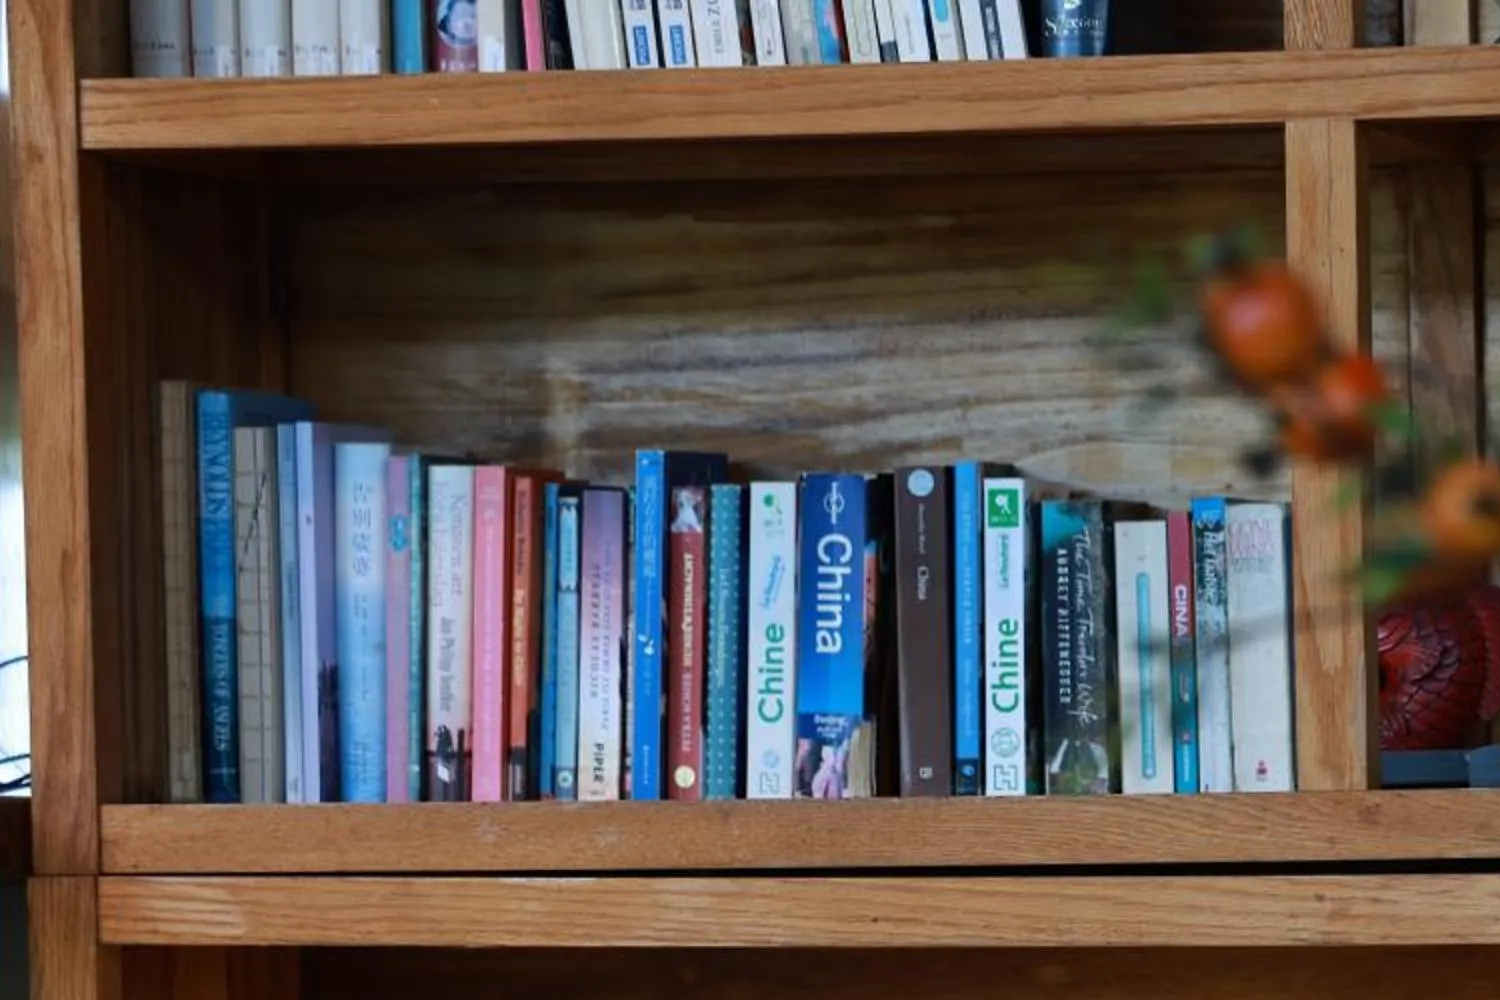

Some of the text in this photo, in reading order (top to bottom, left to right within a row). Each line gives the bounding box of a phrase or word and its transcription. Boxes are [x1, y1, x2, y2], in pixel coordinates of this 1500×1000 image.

[815, 533, 854, 654] China
[916, 566, 930, 600] China
[1056, 548, 1068, 601] AUDREY
[1174, 584, 1188, 637] CINA
[758, 623, 785, 723] Chine
[991, 619, 1019, 713] Chine
[591, 742, 606, 784] PIPER
